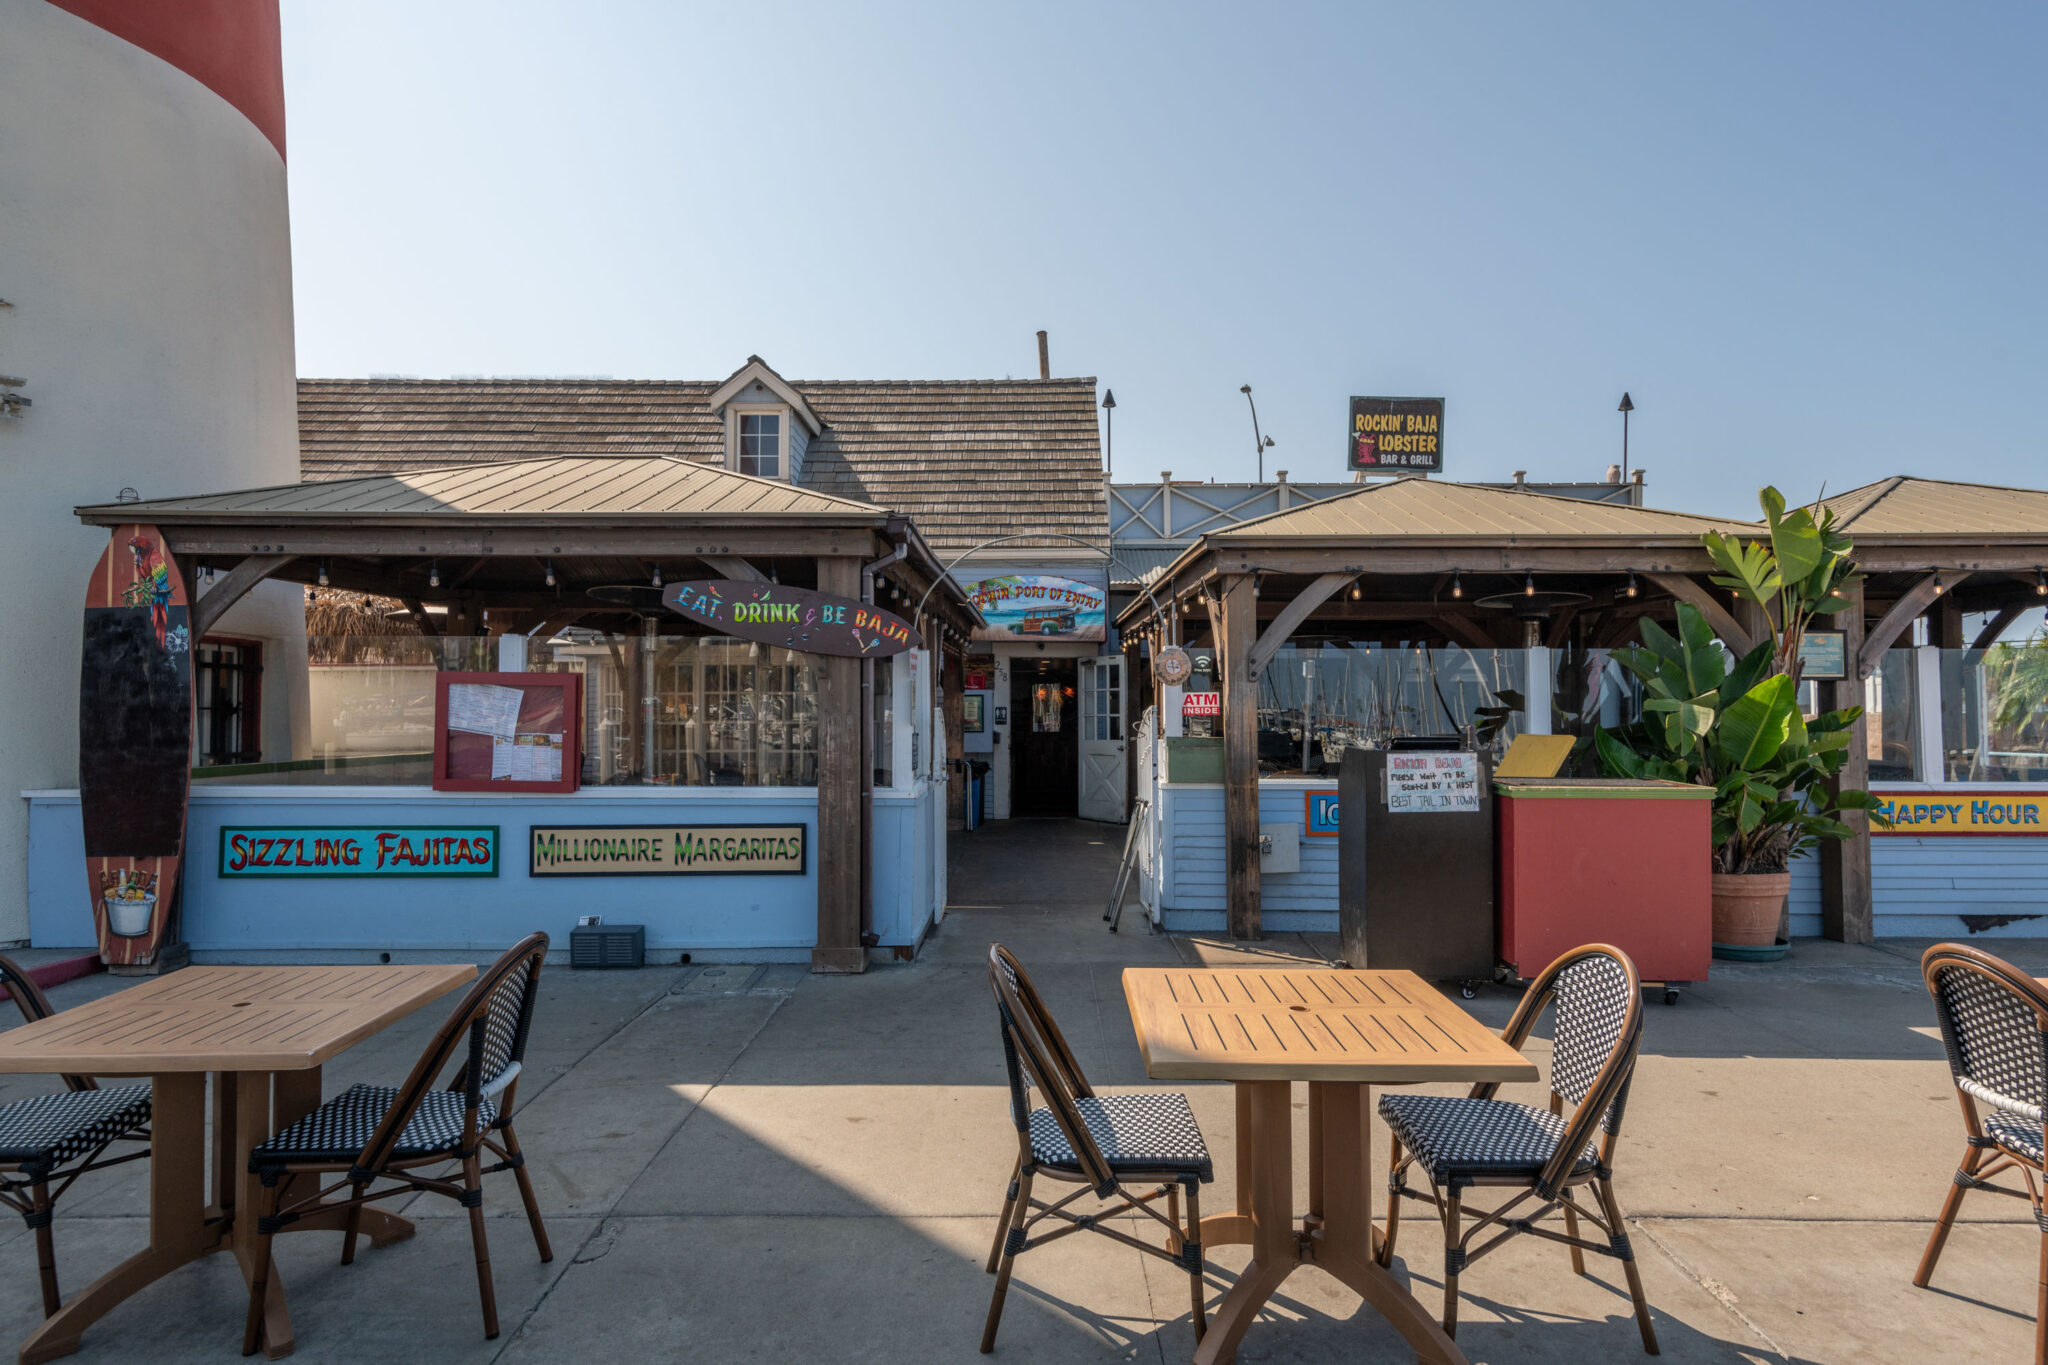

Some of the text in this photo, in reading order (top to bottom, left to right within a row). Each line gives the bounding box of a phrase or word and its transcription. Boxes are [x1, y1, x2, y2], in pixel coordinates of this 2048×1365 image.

[1355, 413, 1438, 433] ROCKIN' BAJA
[1378, 434, 1437, 452] LOBSTER
[1380, 454, 1434, 465] BAR & GRILL
[1015, 585, 1048, 599] PORT
[1049, 587, 1065, 600] OF
[1064, 590, 1102, 609] ENTRY
[732, 602, 801, 623] DRINK
[821, 604, 848, 625] BE
[855, 609, 910, 646] BAJA
[1184, 694, 1218, 706] ATM
[1391, 795, 1413, 808] BEST
[1440, 795, 1452, 806] IN
[1877, 800, 2040, 824] HAPPY HOUR
[229, 832, 490, 871] SIZZLING FAJITAS
[537, 832, 800, 867] MILLIONAIRE MARGARITAS
